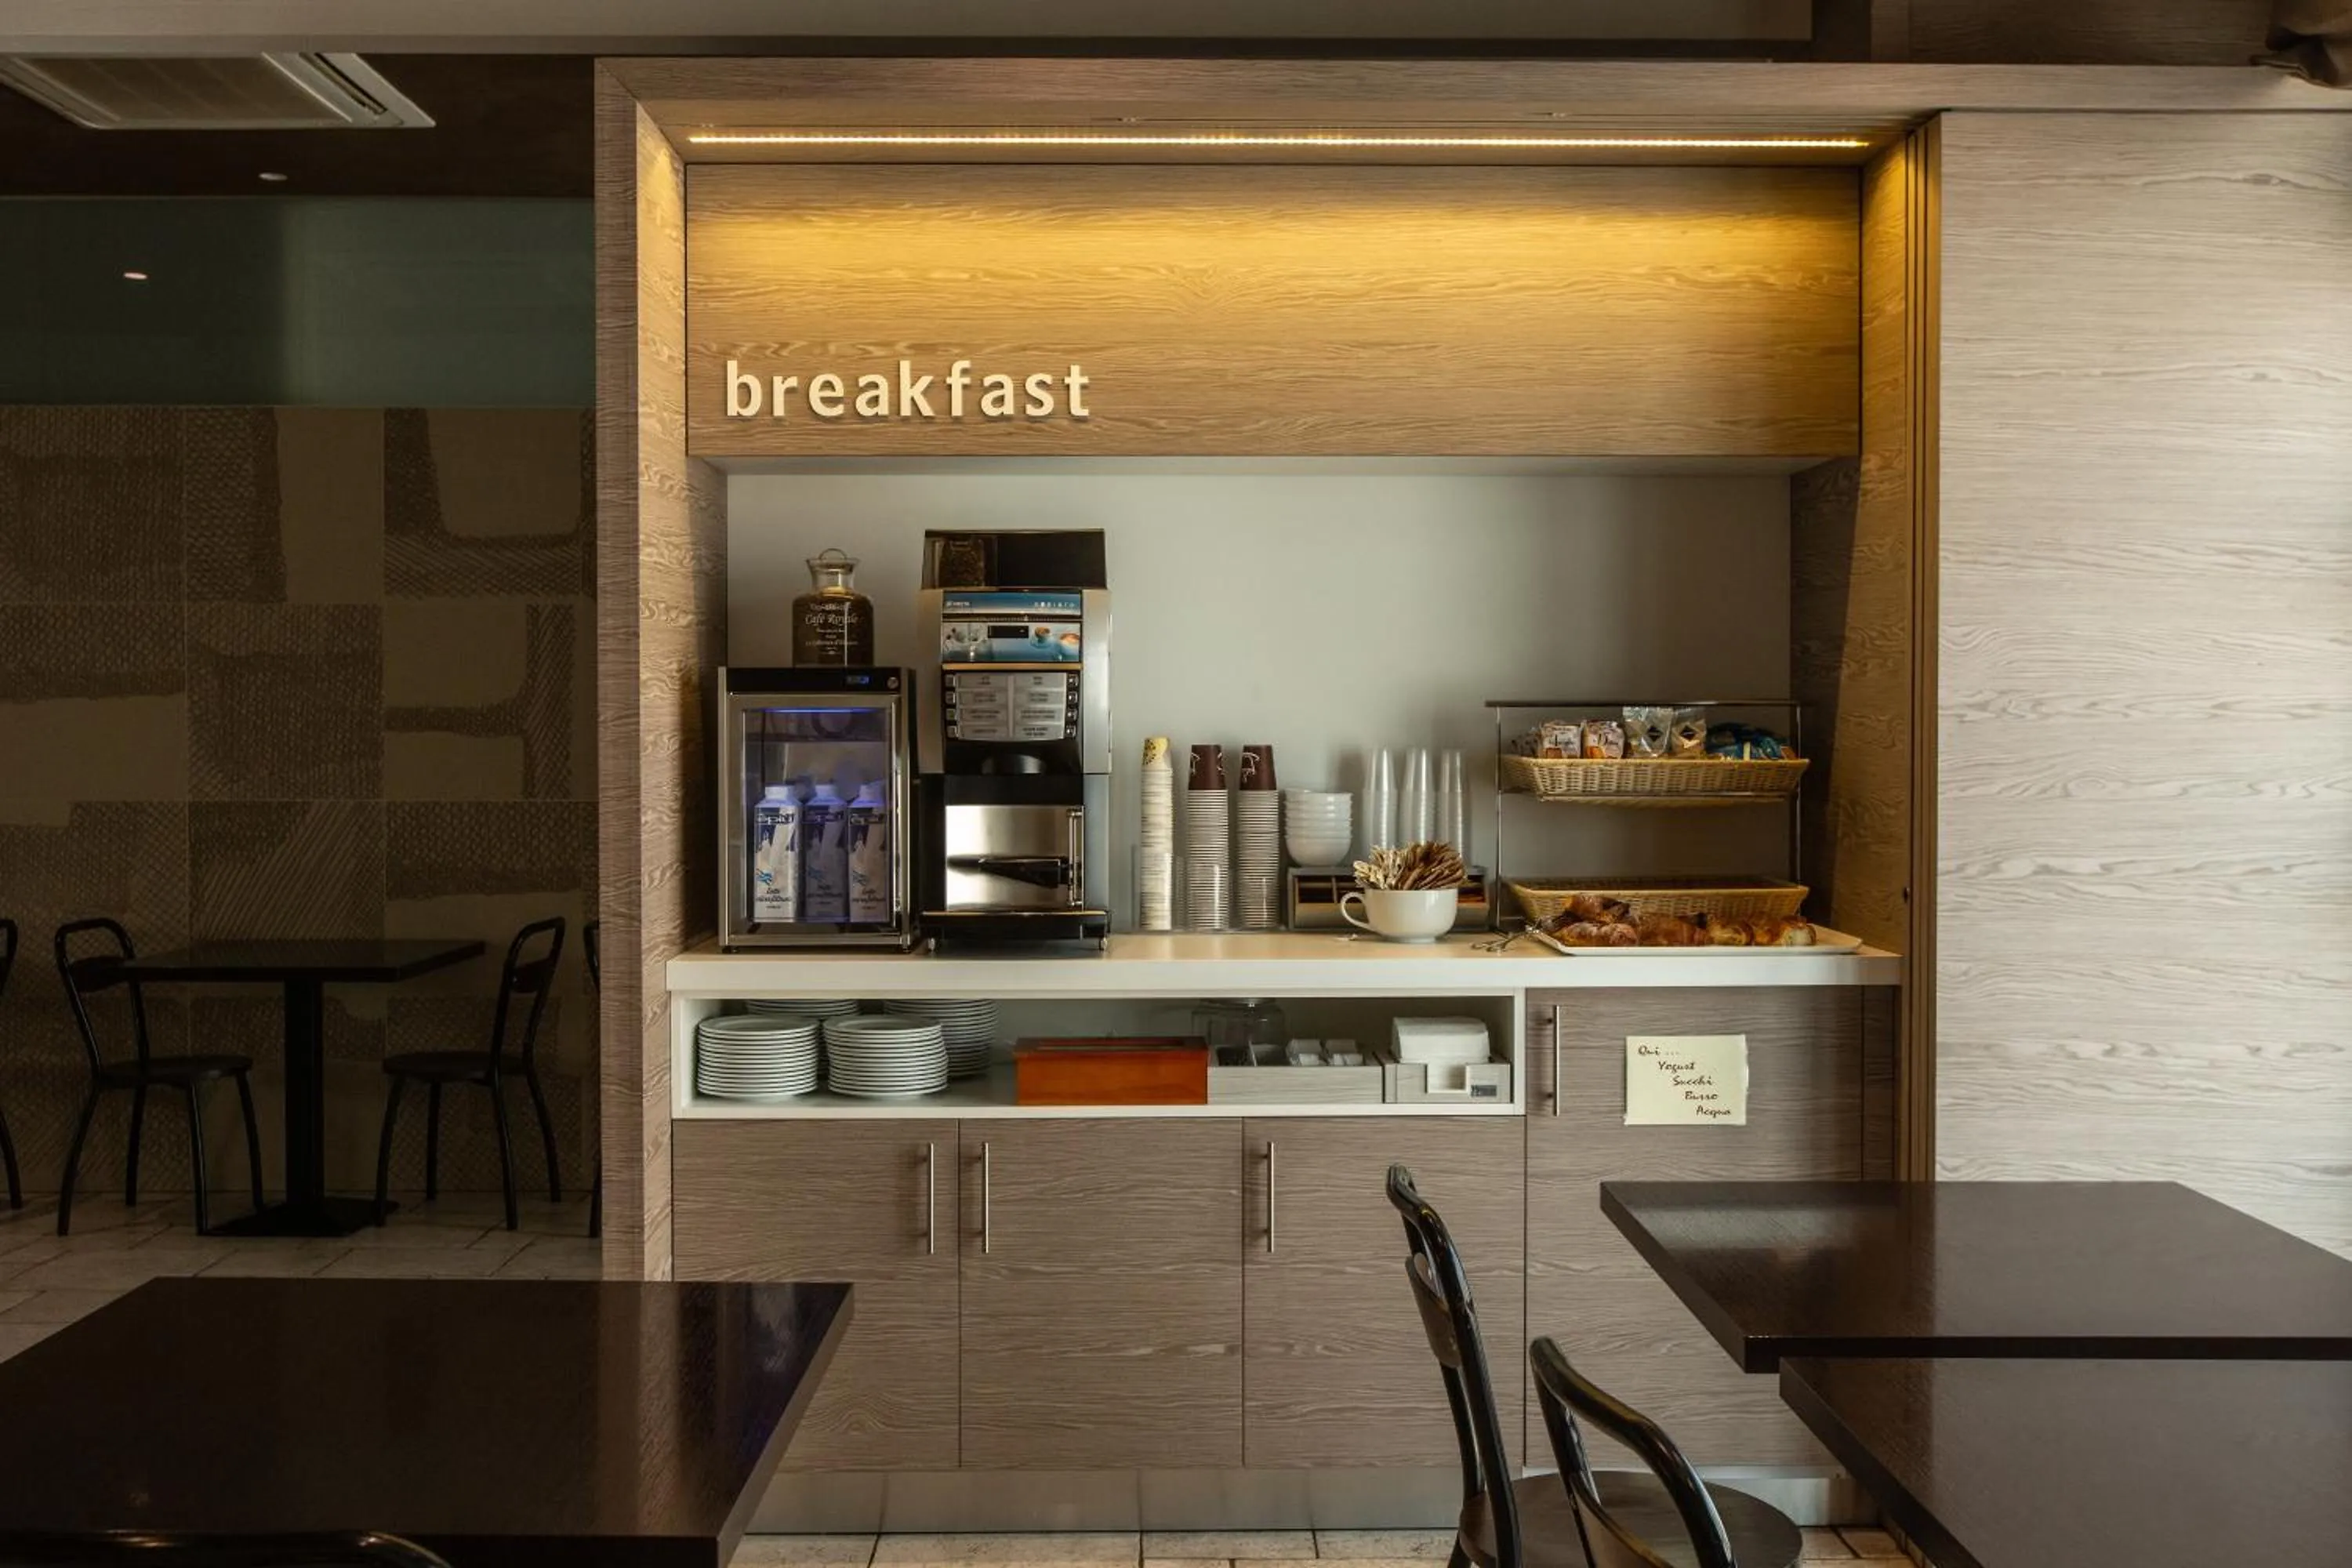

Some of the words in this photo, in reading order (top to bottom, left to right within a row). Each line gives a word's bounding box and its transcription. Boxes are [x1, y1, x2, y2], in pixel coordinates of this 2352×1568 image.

[726, 360, 1090, 417] breakfast
[1638, 1044, 1661, 1056] Qui
[1672, 1075, 1714, 1087] Succhi
[1685, 1091, 1719, 1101] Burro
[1696, 1104, 1731, 1118] Acqua
